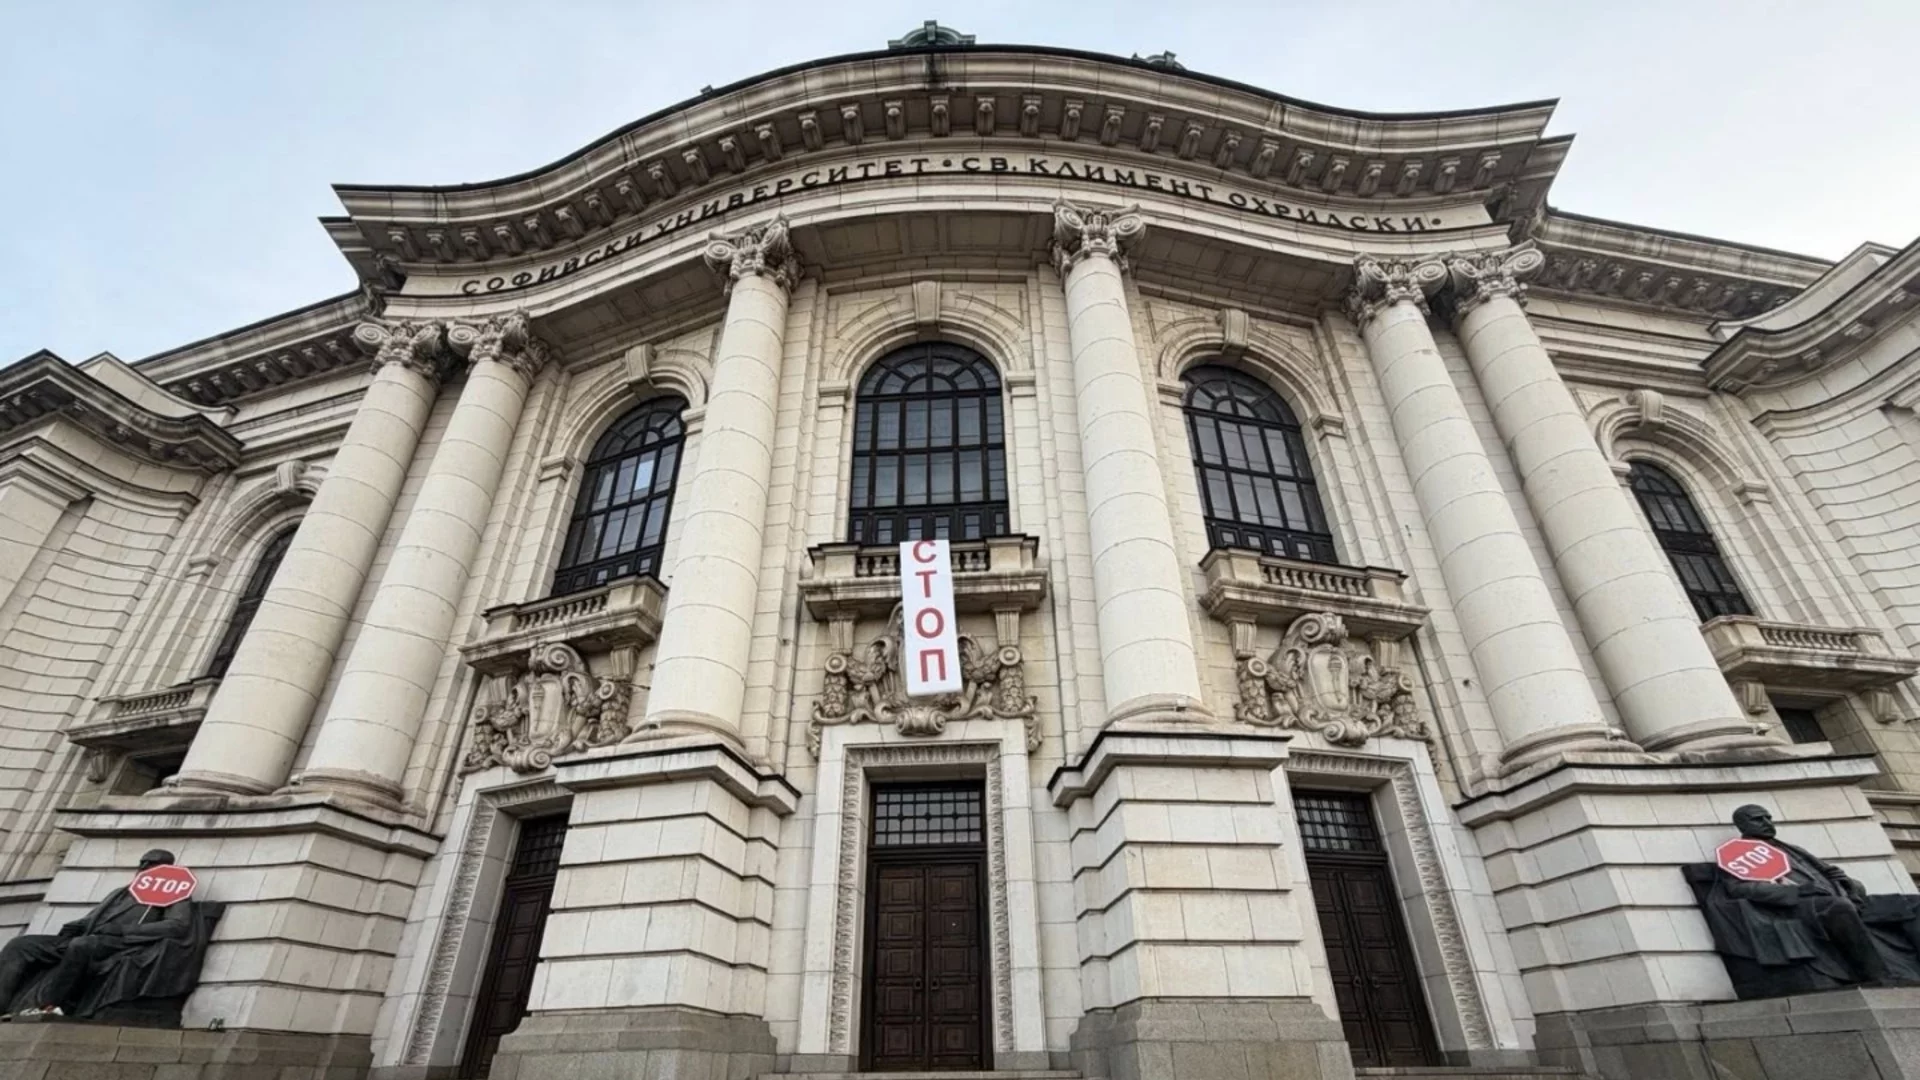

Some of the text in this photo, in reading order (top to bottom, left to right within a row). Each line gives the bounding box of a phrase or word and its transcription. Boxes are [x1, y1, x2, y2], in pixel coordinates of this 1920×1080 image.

[657, 158, 929, 236] УНИВЕРСИТЕТ
[1029, 158, 1212, 200] КЛИМЕНТ
[912, 540, 947, 682] СТОП
[137, 876, 190, 895] STOP
[1727, 845, 1773, 875] STOP
